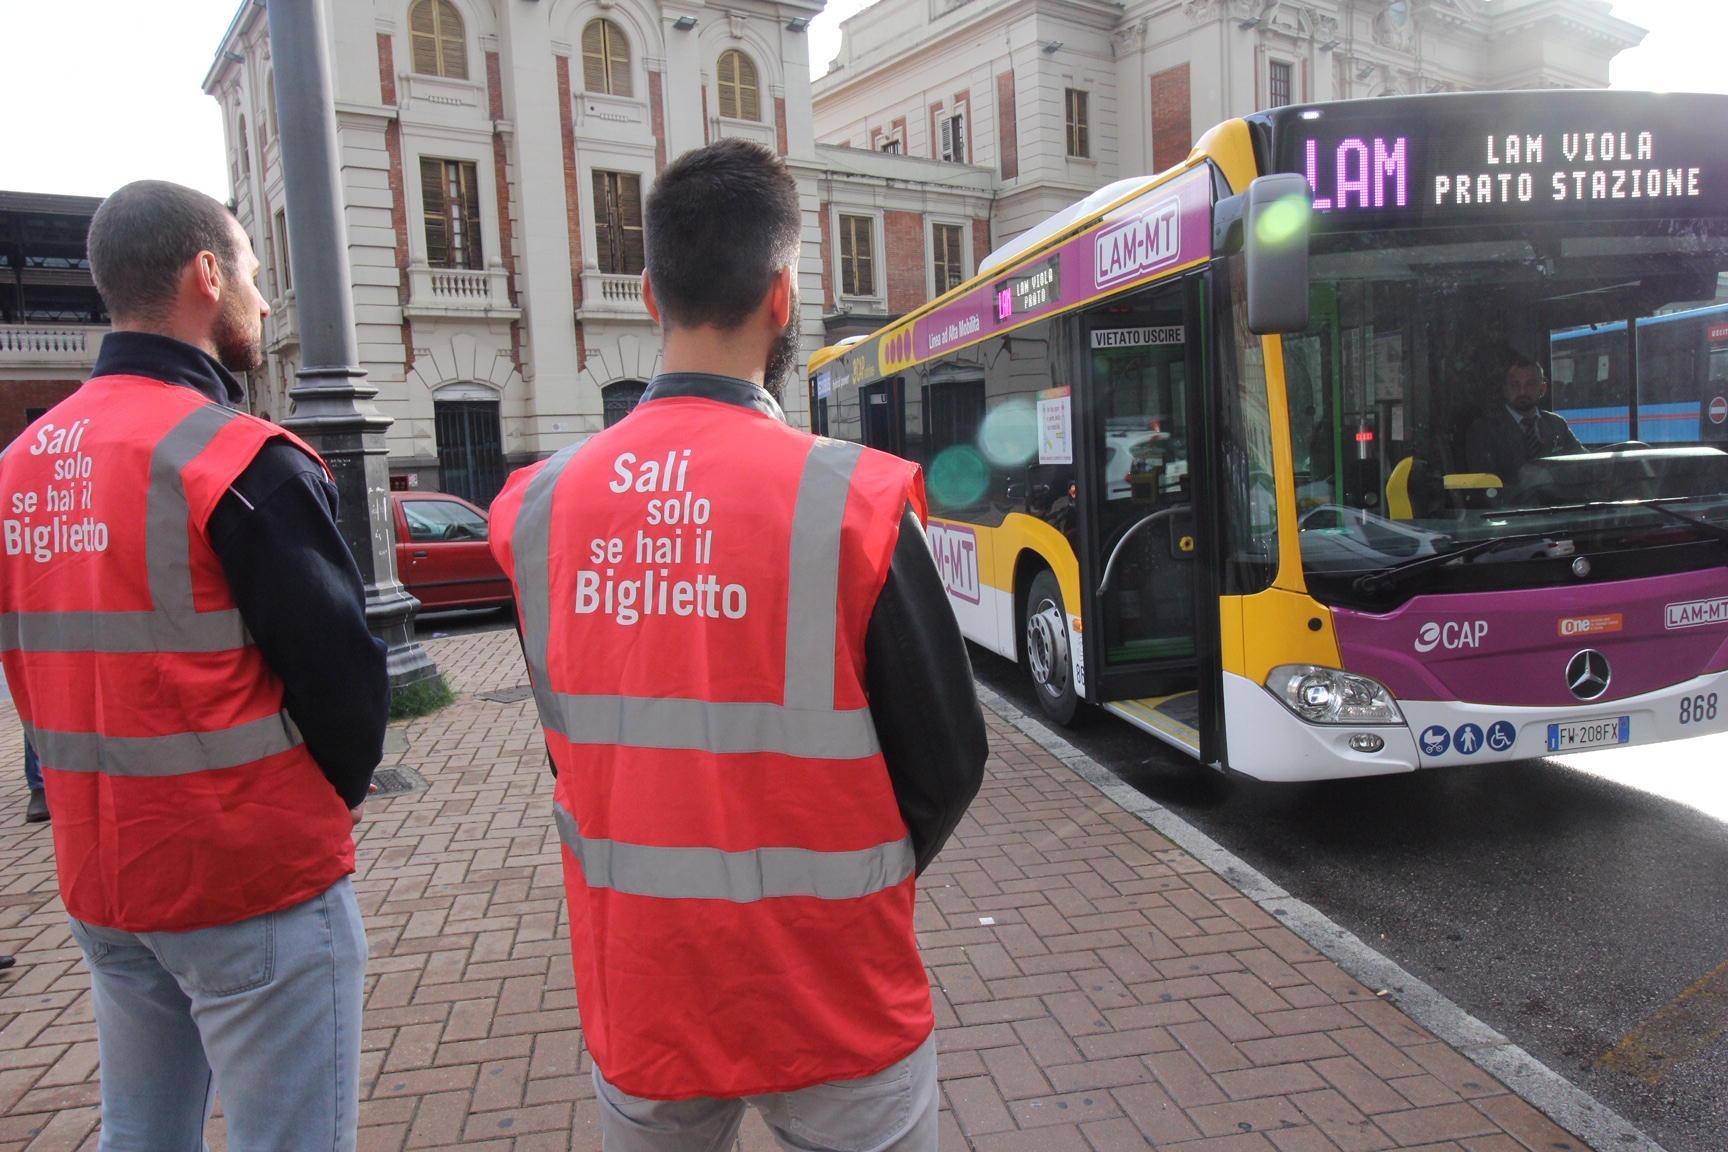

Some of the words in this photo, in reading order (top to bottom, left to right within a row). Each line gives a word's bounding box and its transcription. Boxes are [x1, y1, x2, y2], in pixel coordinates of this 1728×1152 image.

[1487, 134, 1543, 165] LAM
[1562, 131, 1653, 162] VIOLA
[1306, 137, 1406, 209] LAM
[1435, 172, 1533, 205] PRATO
[1552, 167, 1700, 200] STAZIONE
[1099, 210, 1176, 278] LAM-MT
[1031, 268, 1054, 290] VIOLA
[1024, 288, 1046, 309] PRATO
[928, 333, 941, 349] Linea
[948, 323, 959, 342] Alta
[1095, 330, 1140, 346] VIETATO
[1143, 328, 1181, 344] USCIRE
[30, 419, 91, 456] Sali
[54, 452, 92, 481] solo
[608, 449, 691, 493] Sali
[12, 491, 38, 514] se
[47, 485, 75, 512] hai
[81, 481, 93, 509] il
[646, 492, 711, 525] solo
[3, 515, 109, 563] Biglietto
[590, 538, 623, 564] se
[635, 529, 682, 564] hai
[695, 528, 712, 564] il
[931, 531, 974, 592] M-MT
[574, 568, 747, 626] Biglietto
[1669, 600, 1728, 624] LAM-MT
[1442, 620, 1489, 649] CAP
[1679, 692, 1718, 725] 868
